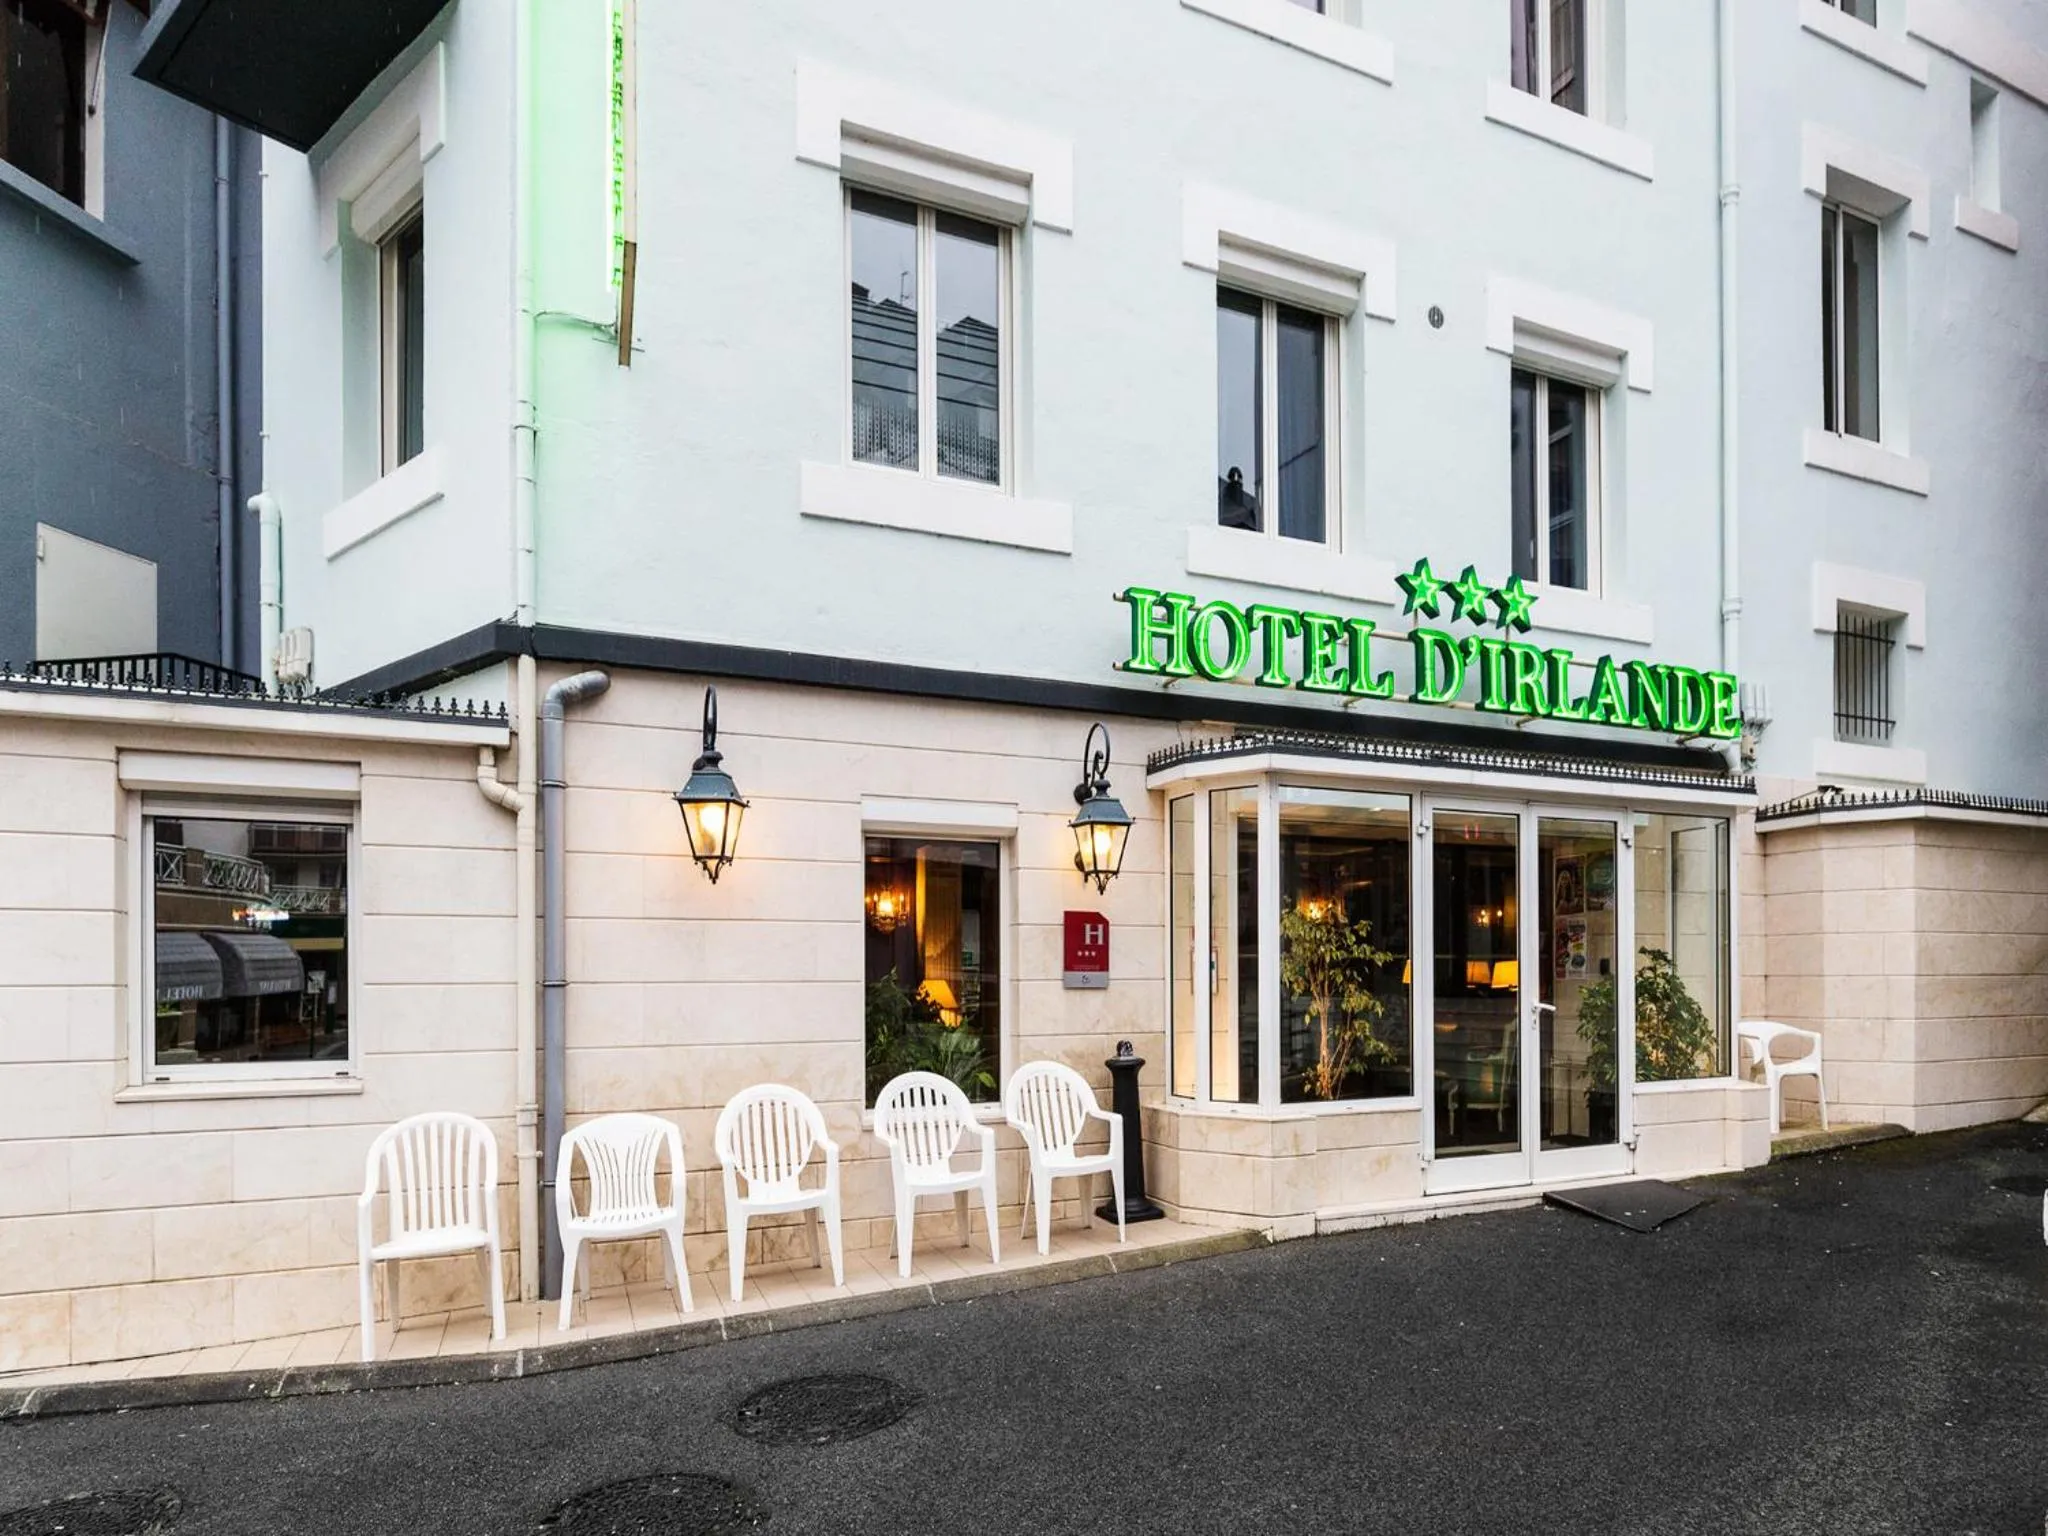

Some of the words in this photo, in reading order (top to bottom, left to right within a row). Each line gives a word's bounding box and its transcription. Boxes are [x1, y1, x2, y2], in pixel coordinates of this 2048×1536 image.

[1123, 586, 1394, 699] HOTEL
[1408, 628, 1743, 740] D'IRLANDE
[1084, 923, 1104, 945] H
